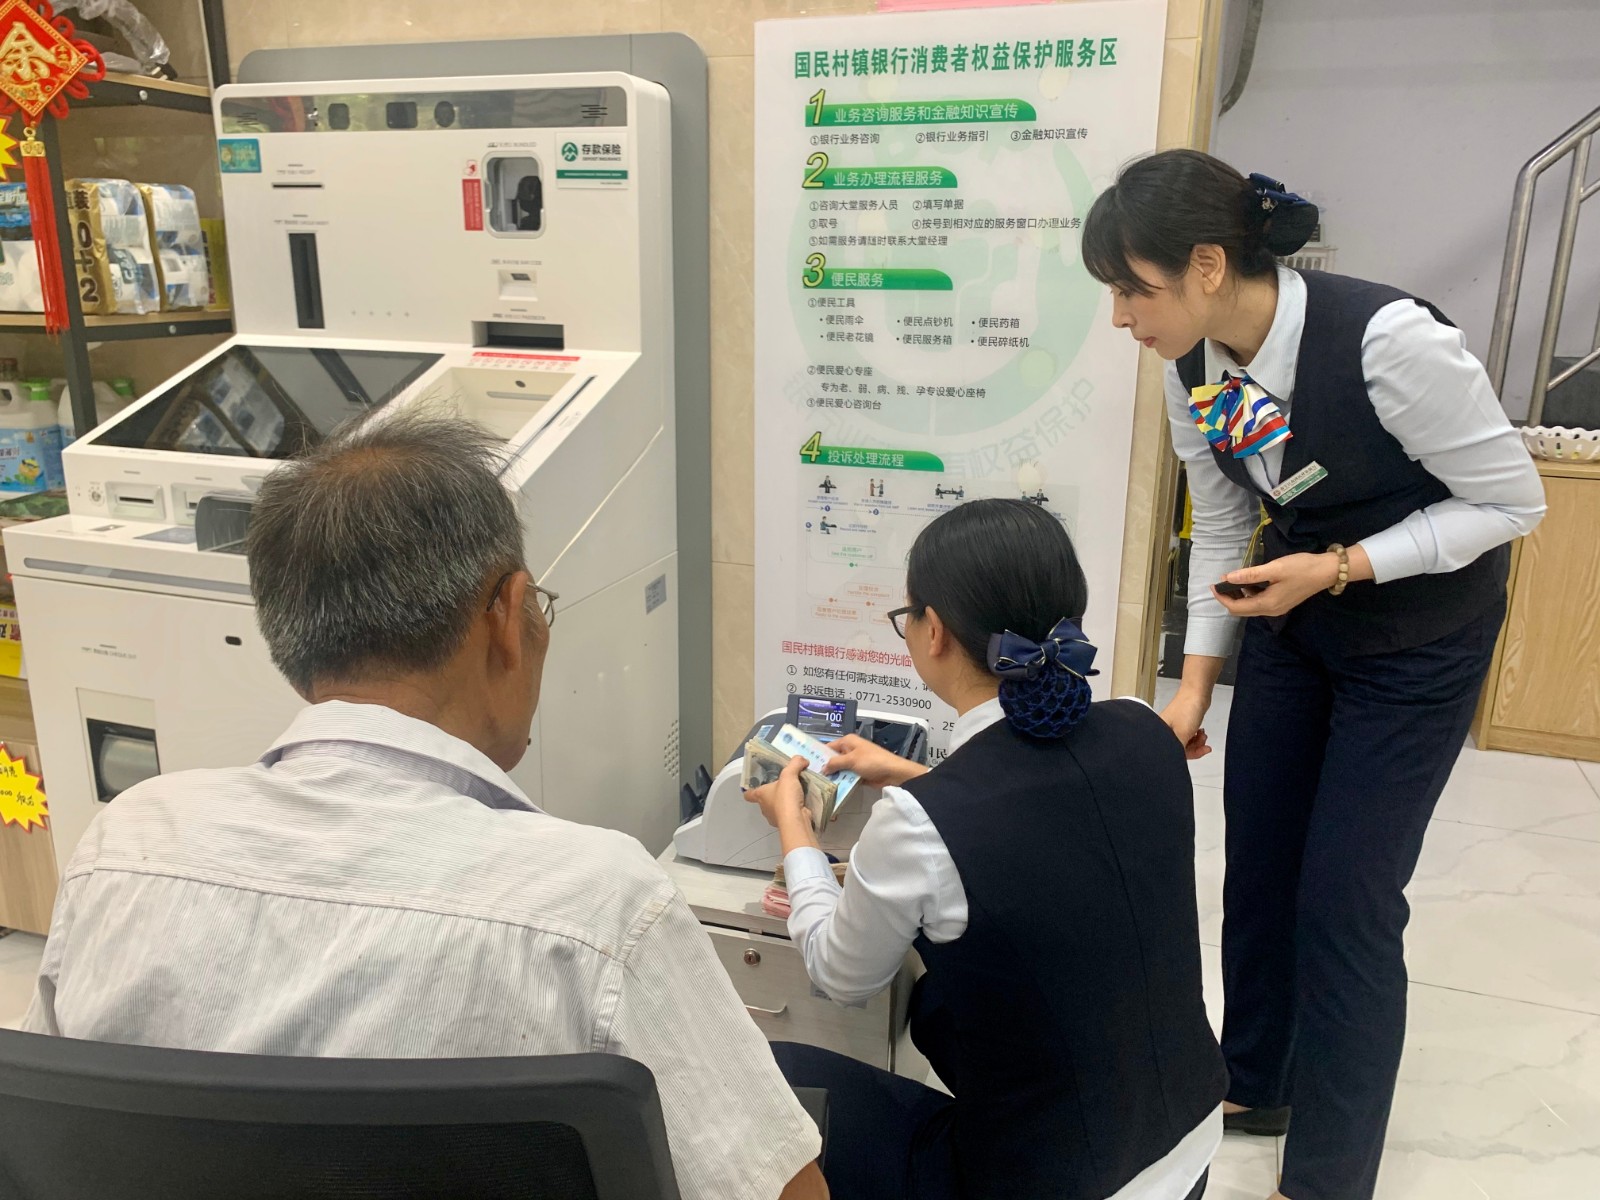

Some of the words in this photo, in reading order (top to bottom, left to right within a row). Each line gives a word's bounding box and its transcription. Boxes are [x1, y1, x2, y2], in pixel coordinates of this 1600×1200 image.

[795, 38, 1118, 78] 国民村镇银行消费者权益保护服务区
[810, 88, 826, 125] 1
[834, 103, 1019, 123] 业务咨询服务和金融知识宣传
[582, 144, 621, 155] 存款保险
[802, 152, 829, 189] 2
[833, 170, 943, 187] 业务办理流程服务
[802, 252, 827, 289] 3
[831, 272, 884, 287] 便民服务
[799, 431, 822, 463] 4
[827, 450, 905, 468] 投诉处理流程
[782, 641, 912, 668] 国民村镇银行感谢您的光临
